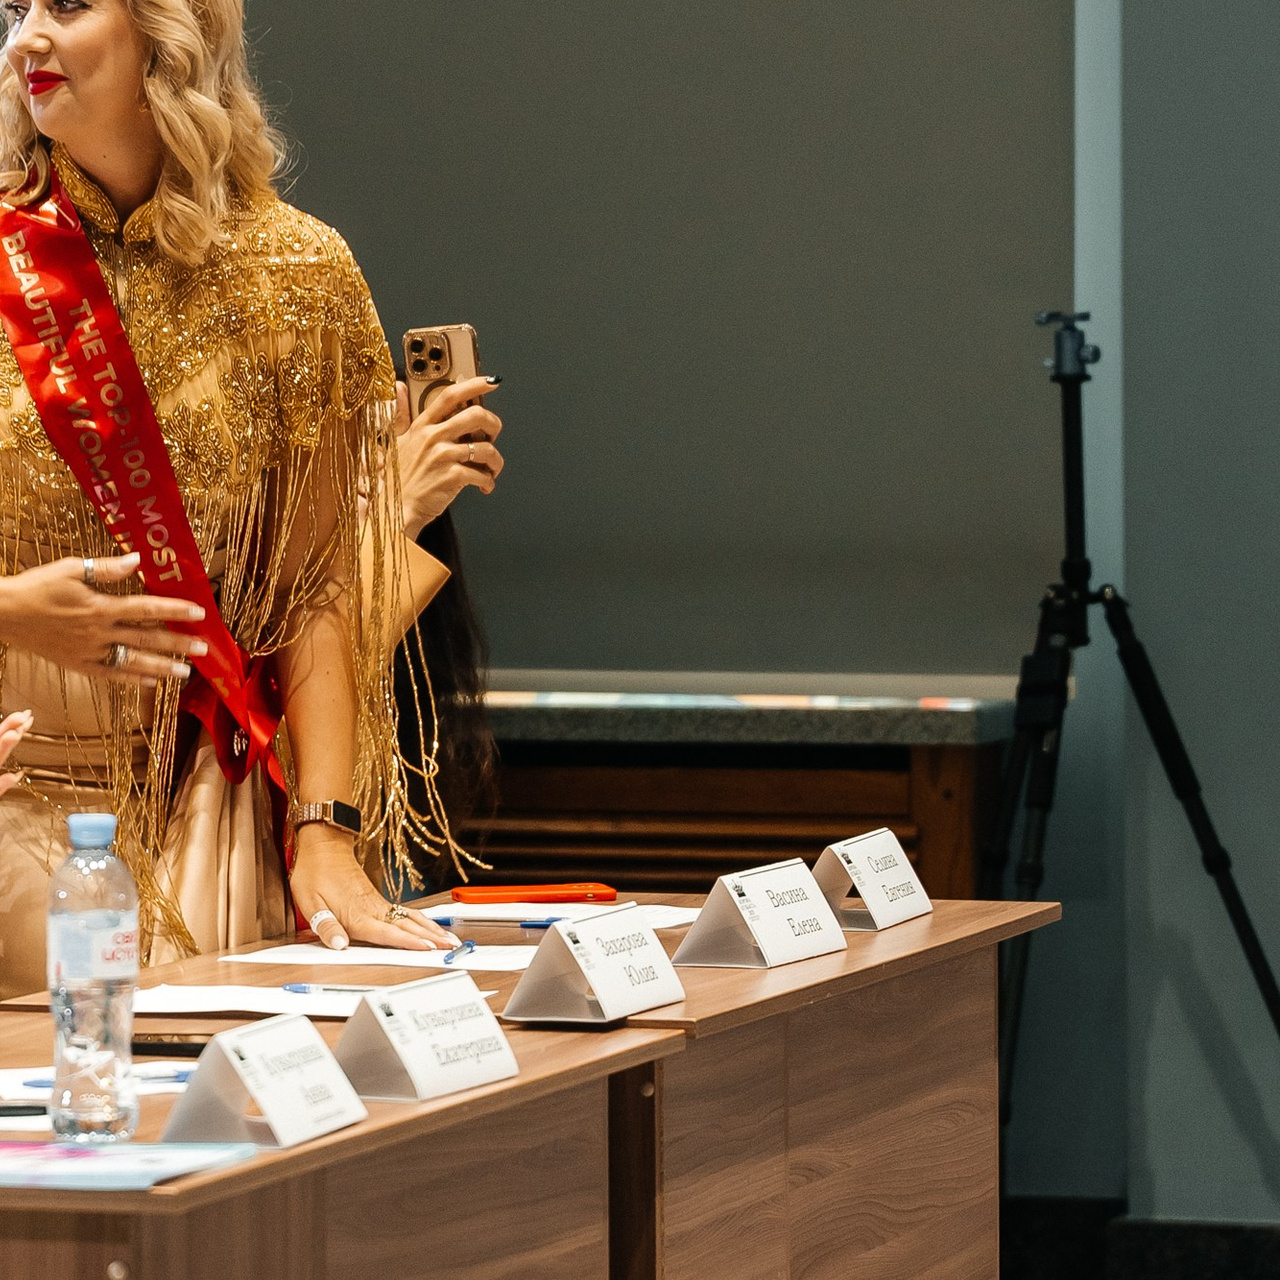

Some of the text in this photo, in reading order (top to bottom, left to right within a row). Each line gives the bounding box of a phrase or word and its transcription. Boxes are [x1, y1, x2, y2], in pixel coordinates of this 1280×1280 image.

[1, 230, 78, 394] BEAUTIFUL
[68, 397, 126, 525] WOMEN
[70, 298, 184, 582] THE TOP-100 MOST
[866, 853, 899, 873] Селина
[765, 887, 809, 908] Васина
[881, 880, 917, 902] Евгения
[786, 917, 823, 937] Елена
[596, 932, 649, 957] Захарова
[623, 964, 659, 986] Юлия
